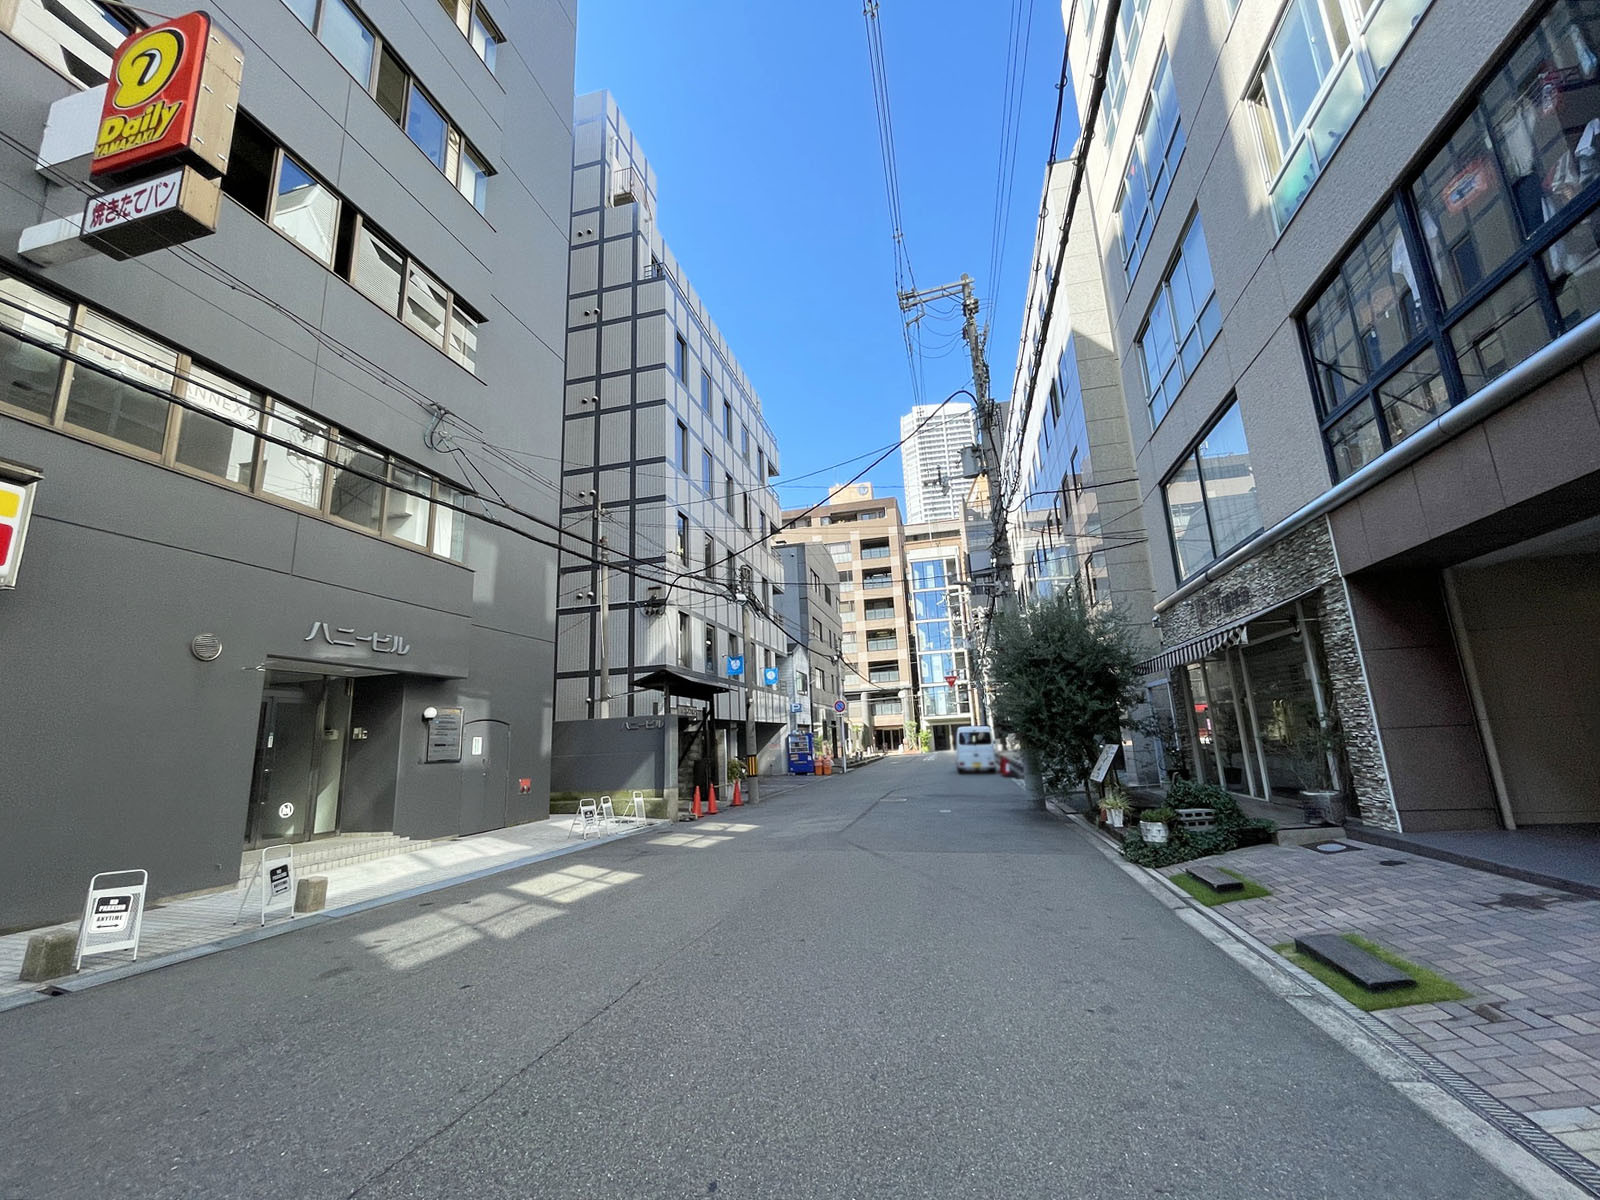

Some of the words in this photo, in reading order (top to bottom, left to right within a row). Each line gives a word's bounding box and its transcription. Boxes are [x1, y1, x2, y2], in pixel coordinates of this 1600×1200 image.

[97, 100, 181, 145] Daily
[94, 129, 155, 158] YAMAZAKI
[89, 181, 176, 229] 焼きたてパン
[247, 408, 257, 421] 2
[303, 621, 411, 655] ハニービル
[791, 704, 801, 713] P
